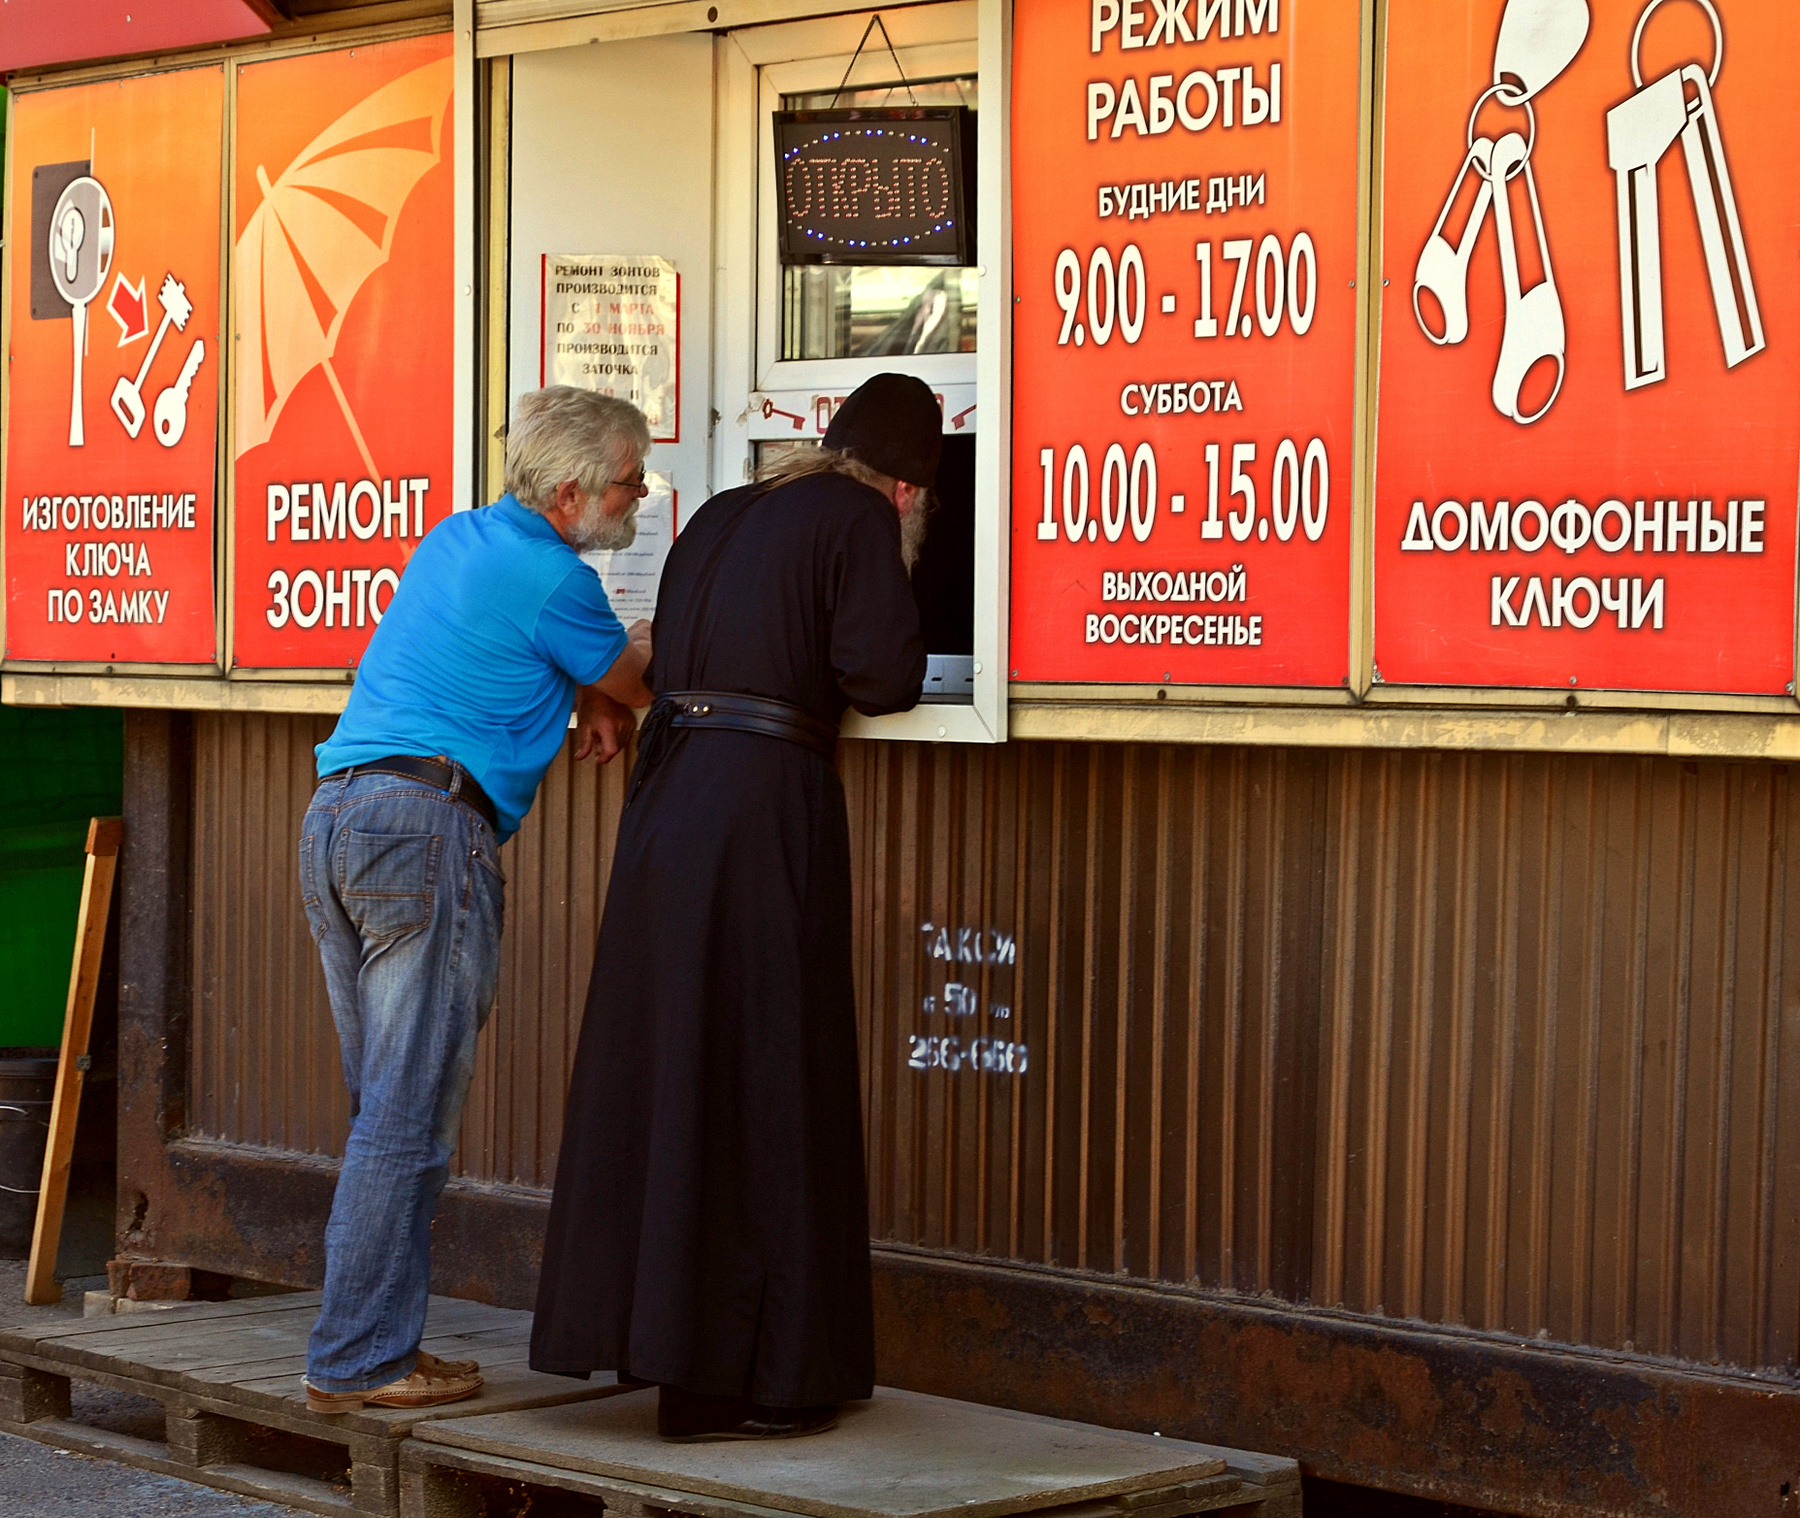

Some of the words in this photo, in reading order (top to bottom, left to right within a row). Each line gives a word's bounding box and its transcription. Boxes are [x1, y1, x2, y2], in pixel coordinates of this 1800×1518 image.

[1092, 0, 1279, 52] РЕЖИМ
[1088, 63, 1281, 140] РАБОТЫ
[786, 158, 949, 218] ОТКРЫТО
[1099, 179, 1200, 219] БУДНИЕ
[1206, 173, 1265, 212] ДНИ
[555, 265, 604, 277] РЕМОНТ
[610, 265, 660, 278] ЗОНТОВ
[556, 283, 658, 296] ПРОИЗВОДИТСЯ
[1055, 244, 1146, 346] 9.00
[1194, 232, 1317, 338] 17.00
[571, 302, 579, 314] С
[595, 302, 601, 314] 1
[609, 302, 655, 315] МАРТА
[557, 322, 575, 334] ПО
[583, 322, 601, 335] 30
[608, 322, 665, 336] НОЯБРЯ
[556, 343, 659, 356] ПРОИЗВОДИТСЯ
[582, 363, 639, 375] ЗАТОЧКА
[1121, 380, 1243, 416] СУББОТА
[1037, 442, 1157, 543] 10.00
[1201, 437, 1329, 542] 15.00
[22, 494, 196, 531] ИЗГОТОВЛЕНИЕ
[267, 478, 429, 541] РЕМОНТ
[1401, 499, 1765, 554] ДОМОФОННЫЕ
[66, 542, 152, 577] КЛЮЧА
[266, 568, 400, 628] ЗОНТО
[1102, 564, 1246, 602] ВЫХОДНОЙ
[48, 589, 84, 623] ПО
[88, 589, 170, 624] ЗАМКУ
[1491, 576, 1664, 629] КЛЮЧИ
[1085, 613, 1262, 646] ВОСКРЕСЕНЬЕ
